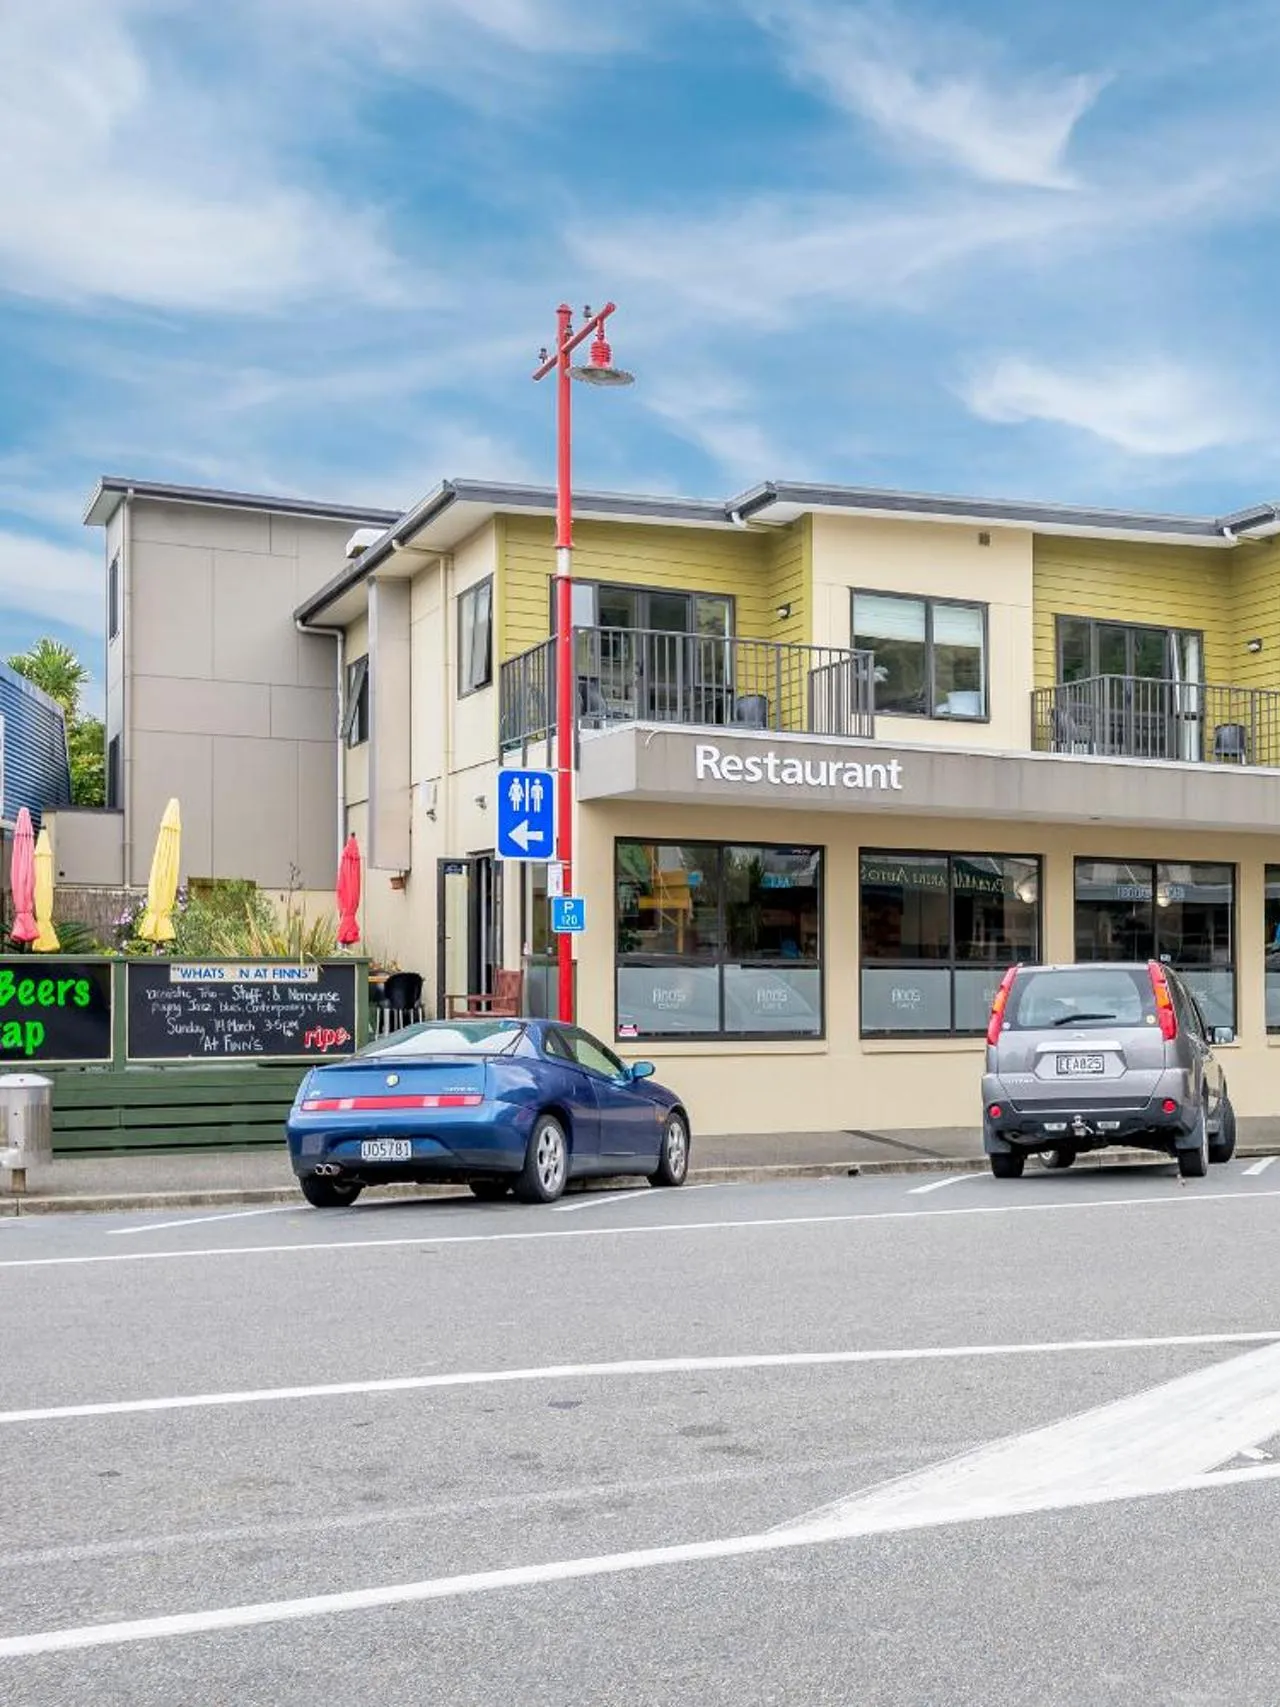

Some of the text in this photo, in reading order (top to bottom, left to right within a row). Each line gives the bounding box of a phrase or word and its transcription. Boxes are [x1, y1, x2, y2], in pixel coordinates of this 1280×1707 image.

[695, 744, 903, 791] Restaurant
[563, 900, 575, 914] P
[561, 914, 578, 926] 120
[254, 968, 268, 979] AT
[0, 969, 91, 1007] Beers
[0, 1021, 45, 1056] ap
